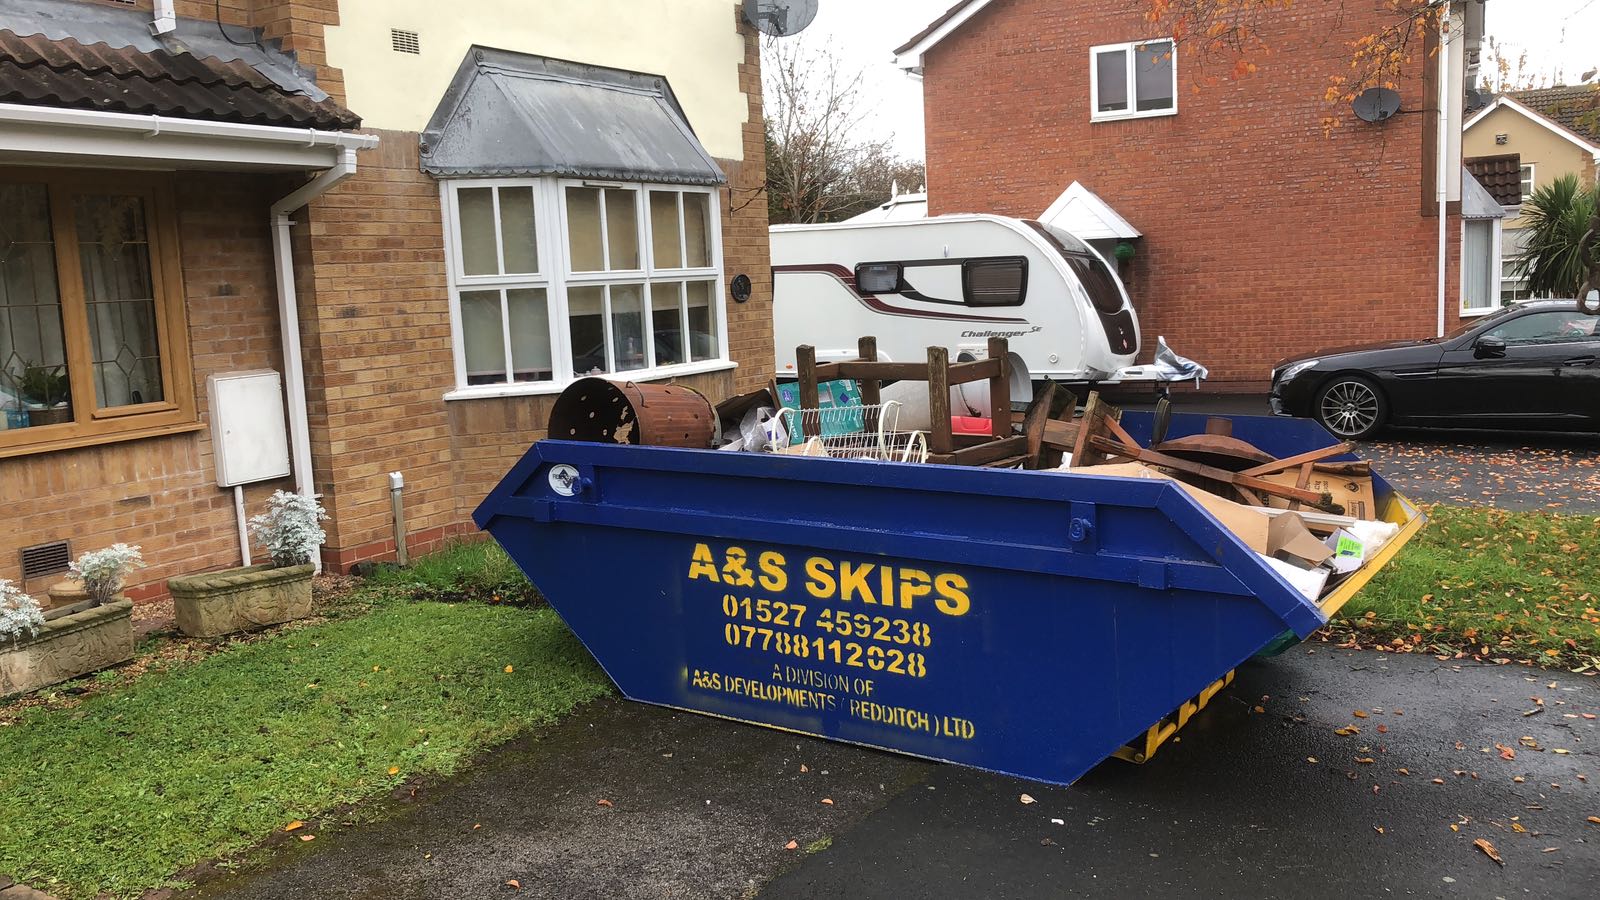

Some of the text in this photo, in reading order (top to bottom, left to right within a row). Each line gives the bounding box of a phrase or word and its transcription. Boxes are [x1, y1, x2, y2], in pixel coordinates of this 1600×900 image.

[961, 330, 1027, 338] Challenger
[688, 543, 970, 616] A&S SKIPS
[723, 594, 931, 647] 01527 459238
[725, 623, 926, 677] 07788112028
[692, 669, 721, 690] A&S
[725, 675, 836, 711] DEVELOPMENTS
[772, 663, 873, 697] A DIVISION OF
